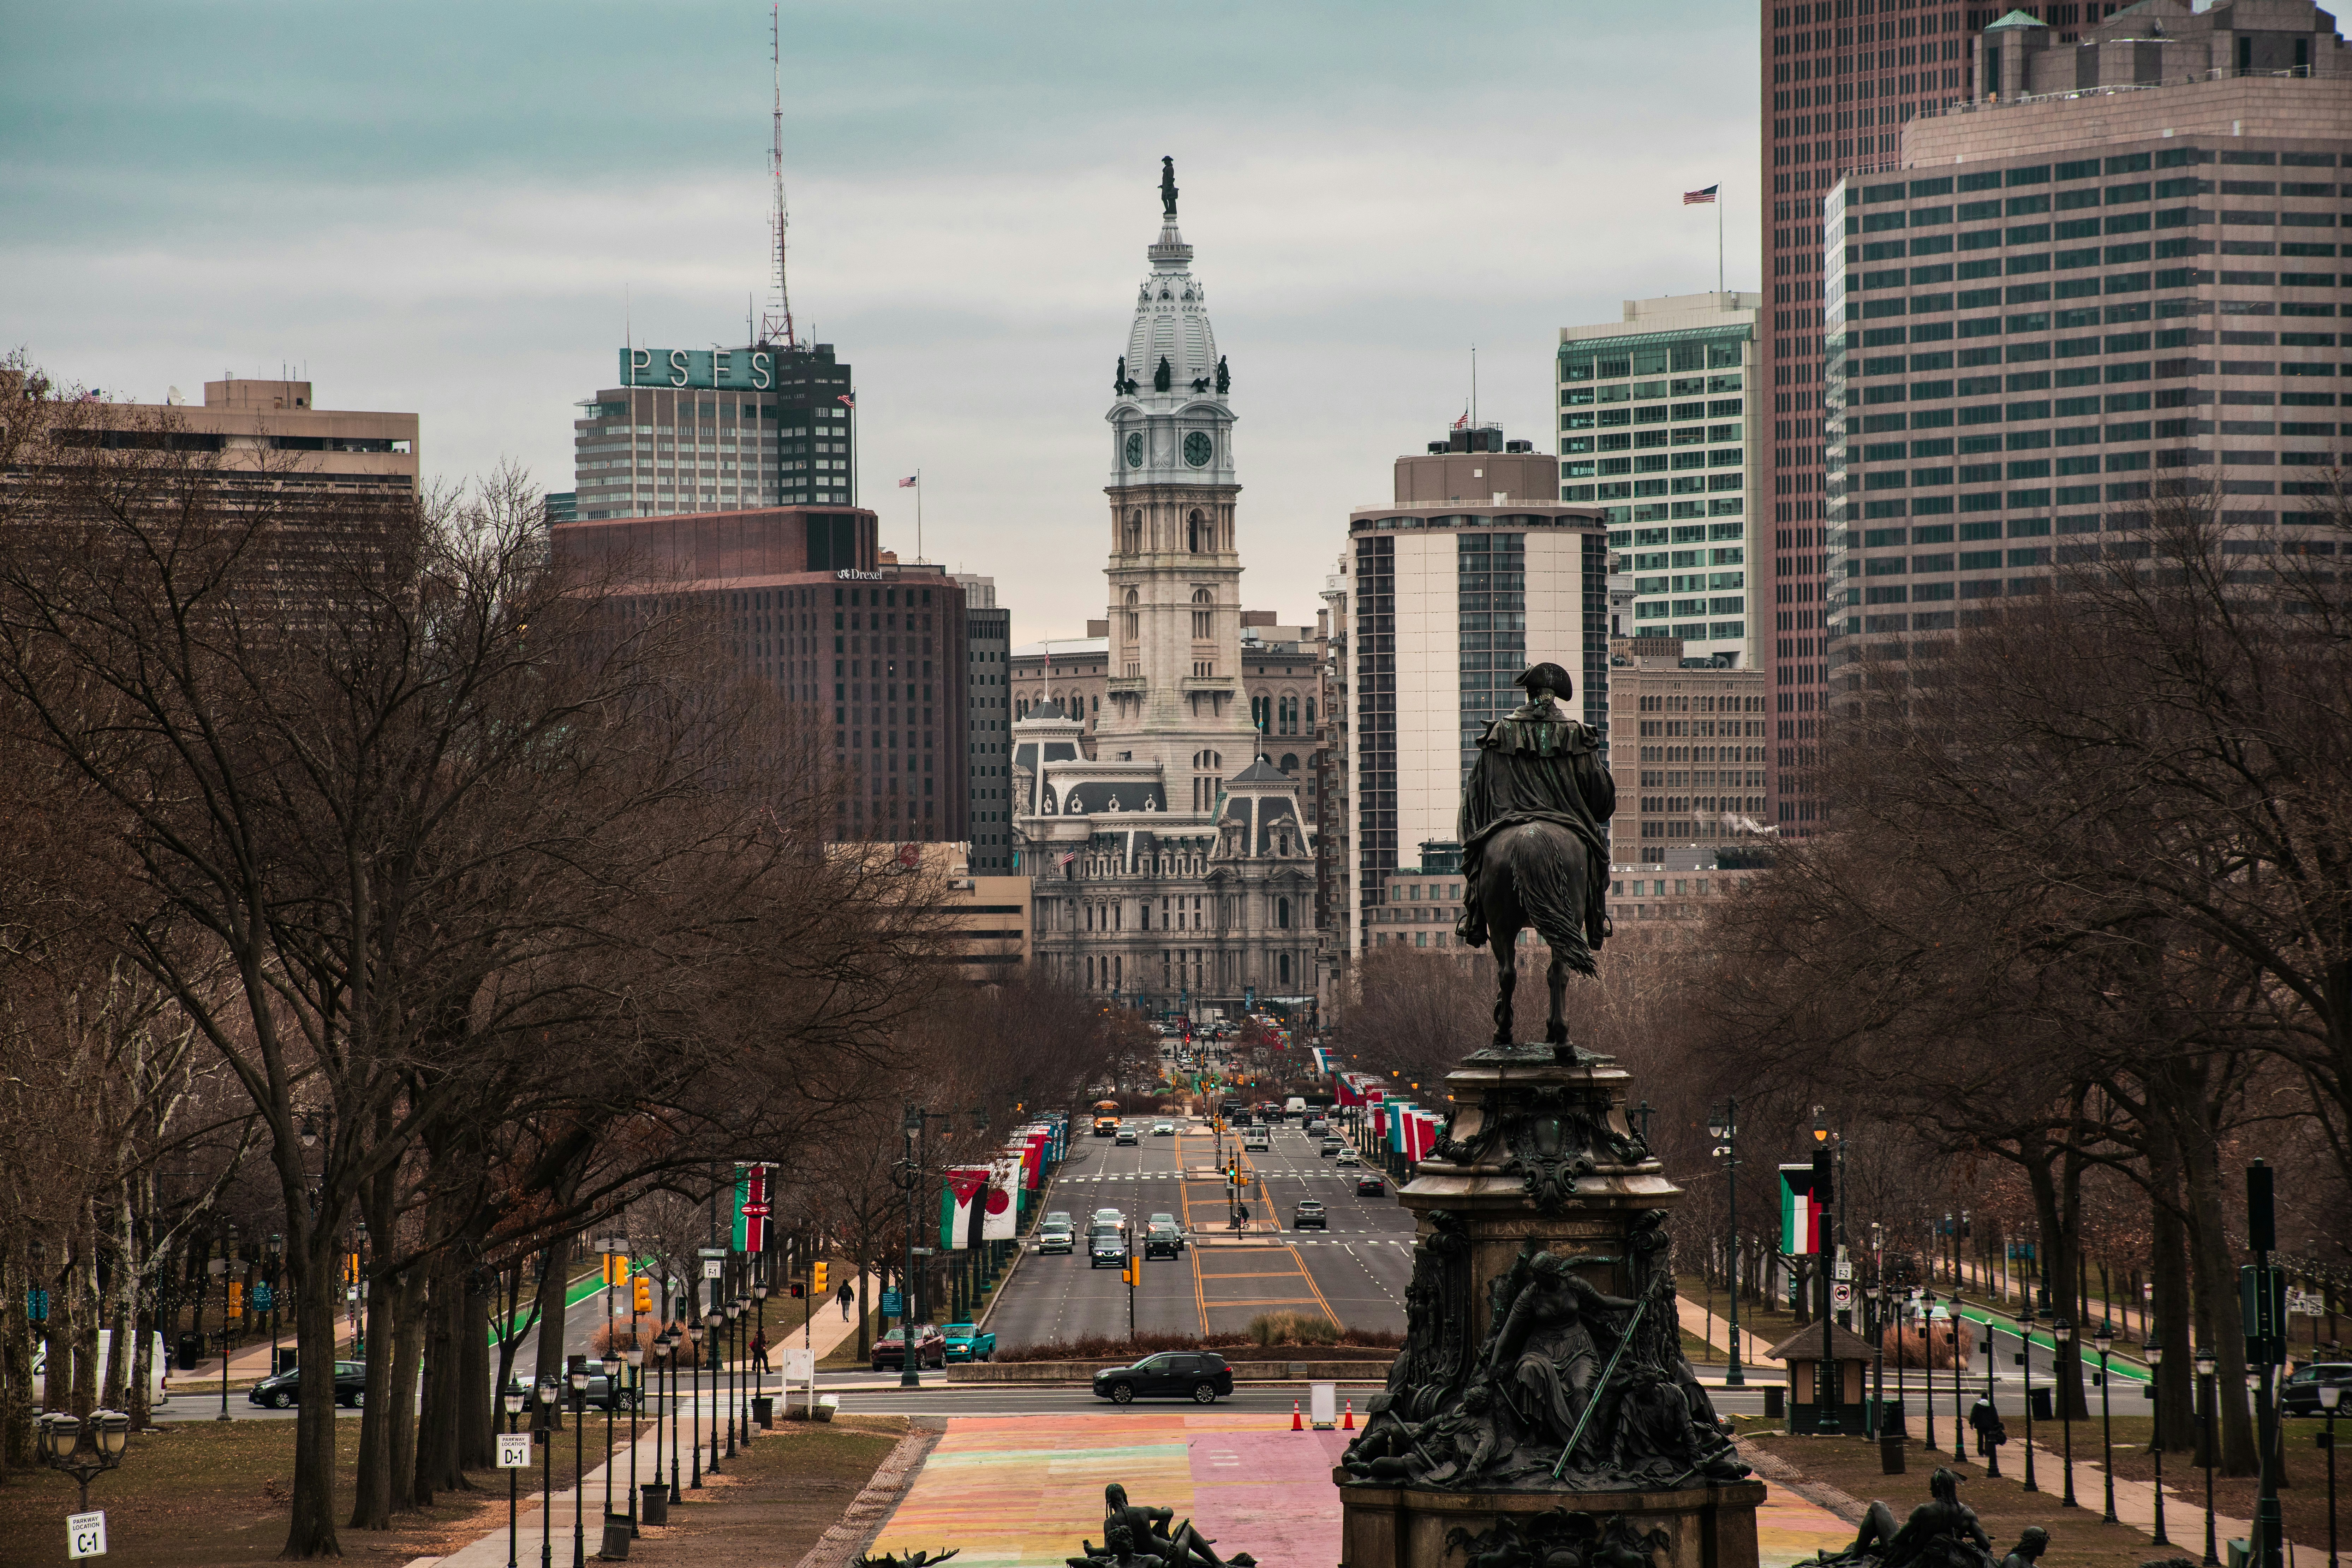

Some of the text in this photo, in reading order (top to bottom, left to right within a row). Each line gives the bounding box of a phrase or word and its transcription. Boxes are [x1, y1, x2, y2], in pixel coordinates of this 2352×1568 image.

[631, 348, 770, 389] PSFS
[851, 568, 883, 580] Drexel
[2310, 1306, 2322, 1314] 25
[505, 1449, 523, 1464] D-1
[73, 1516, 98, 1525] PARKWAY
[73, 1522, 100, 1531] LOCATION
[78, 1532, 96, 1553] C-1
